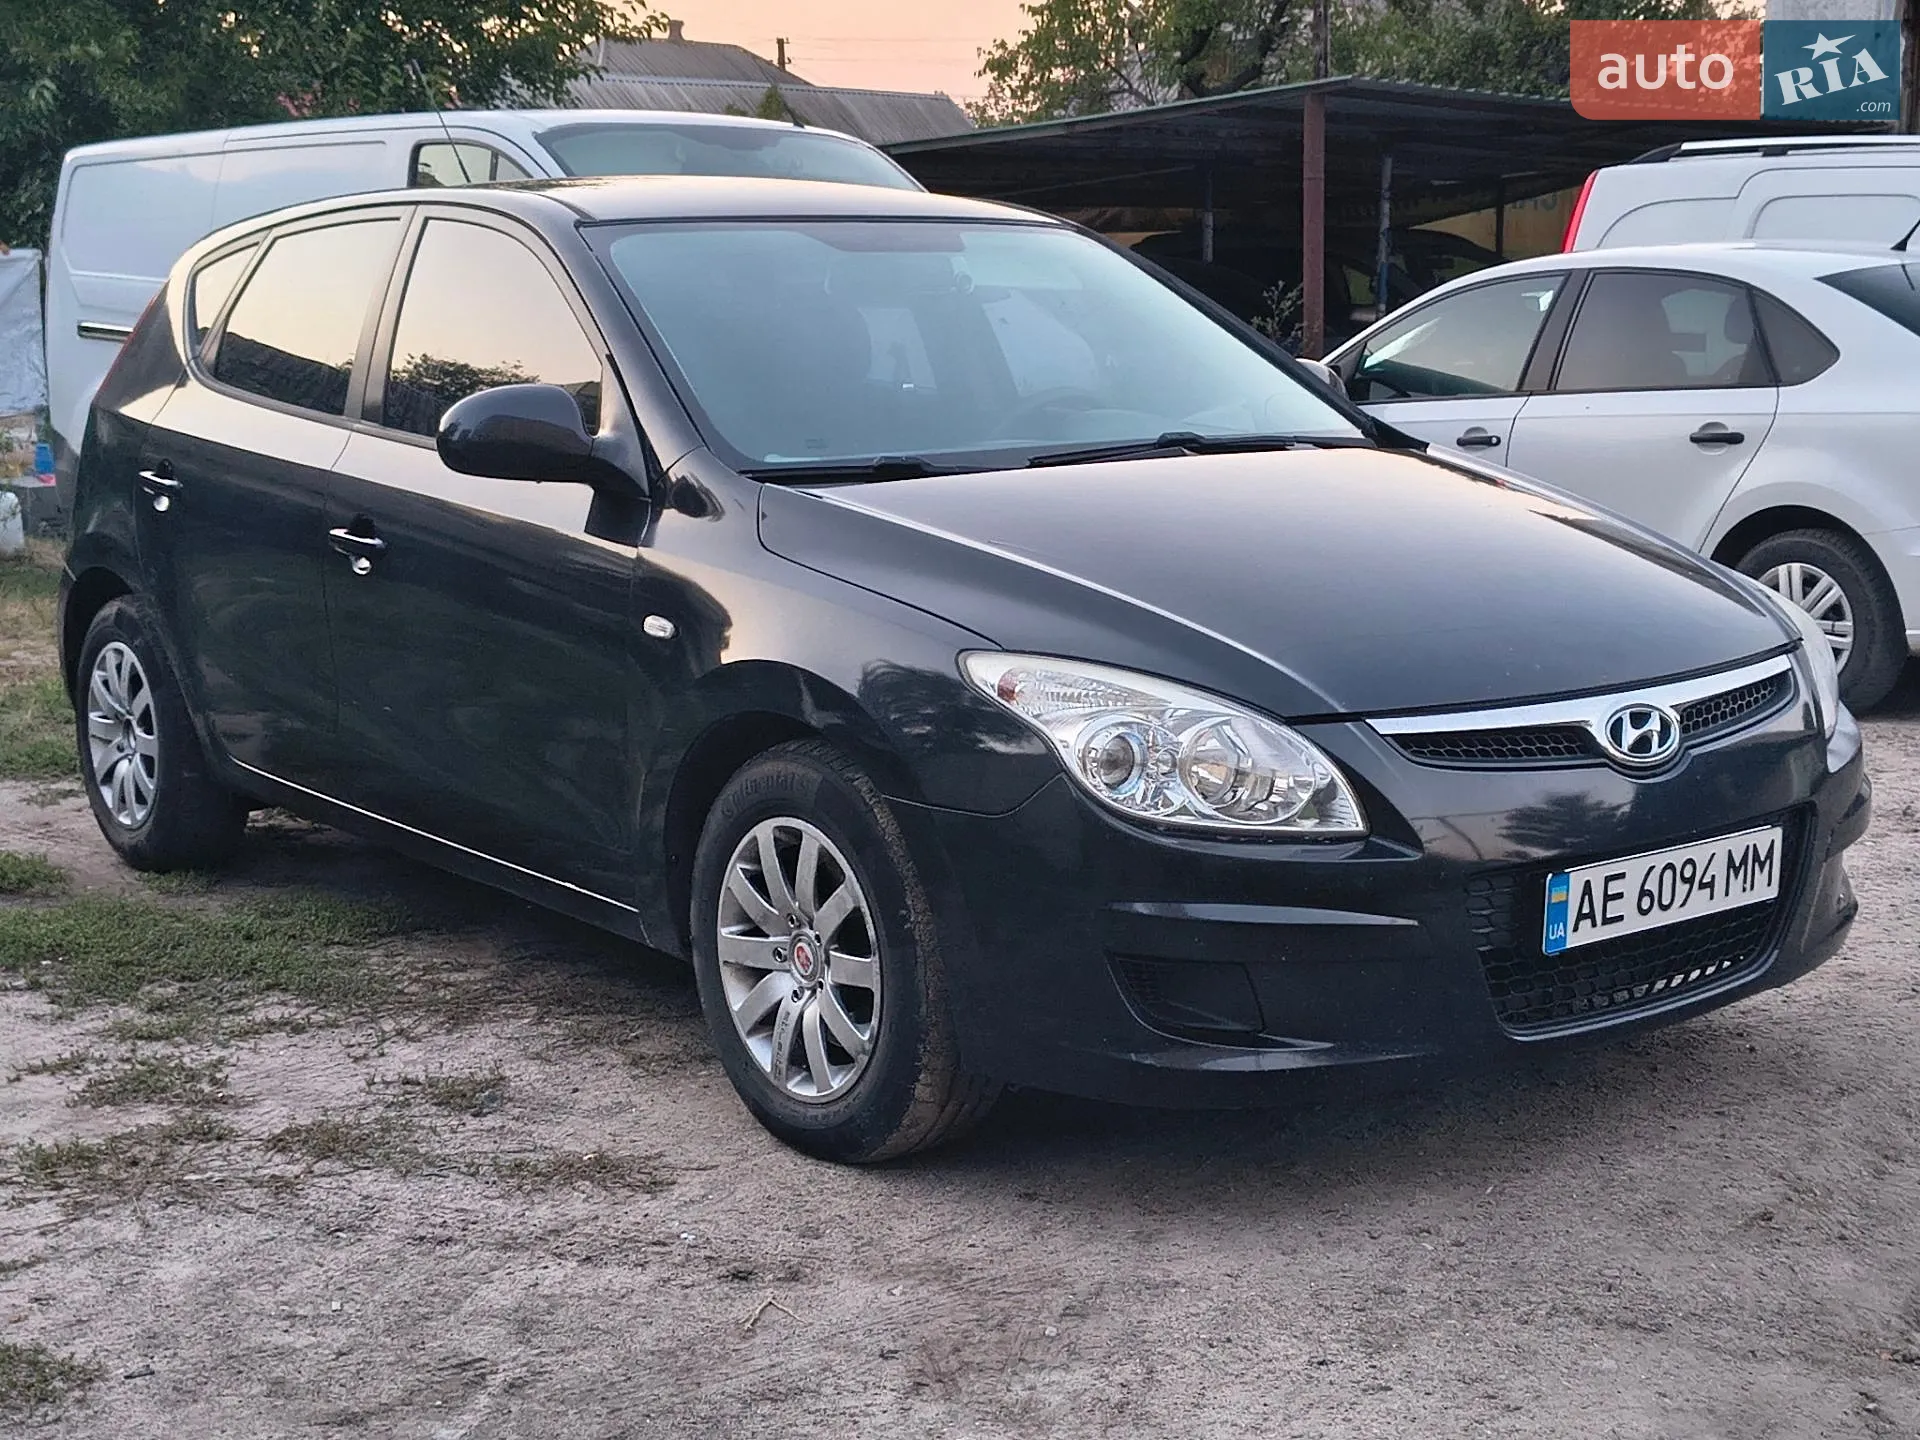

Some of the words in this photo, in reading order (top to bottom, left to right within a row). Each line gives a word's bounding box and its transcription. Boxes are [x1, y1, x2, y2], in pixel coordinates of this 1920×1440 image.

[1571, 871, 1627, 933] AE
[1636, 852, 1717, 917] 6094
[1724, 838, 1776, 898] MM
[1549, 924, 1565, 940] UA
